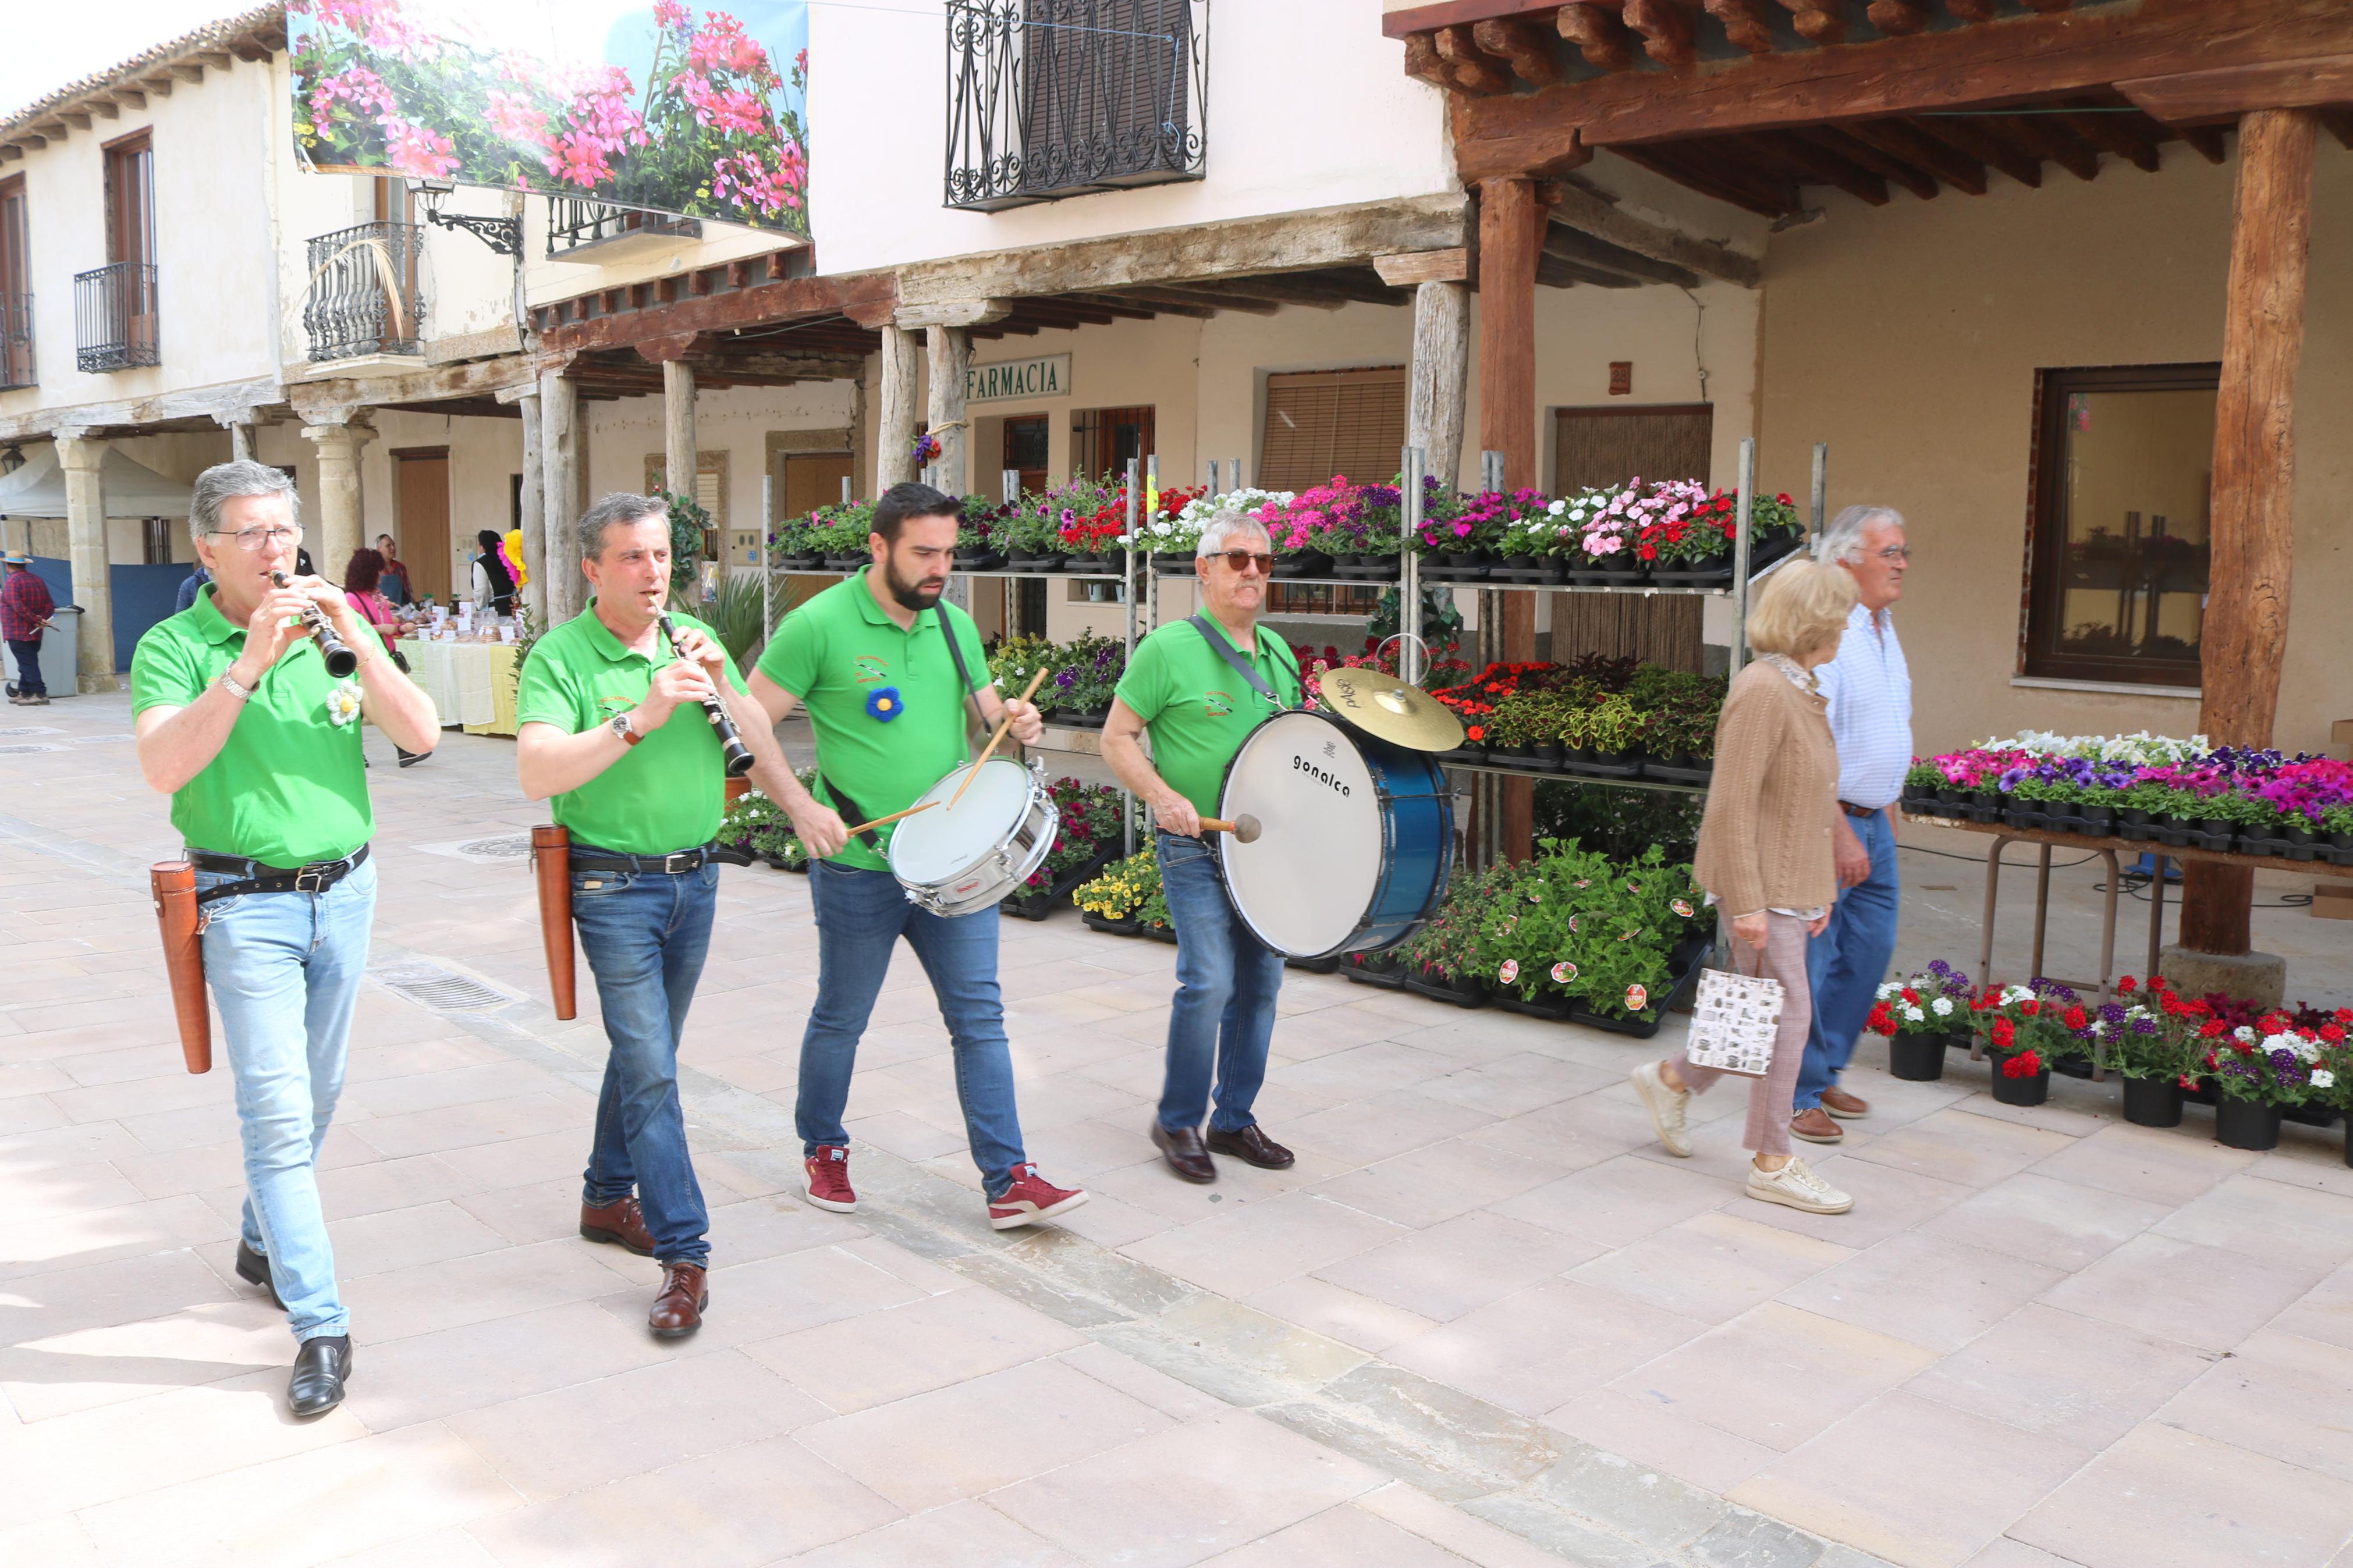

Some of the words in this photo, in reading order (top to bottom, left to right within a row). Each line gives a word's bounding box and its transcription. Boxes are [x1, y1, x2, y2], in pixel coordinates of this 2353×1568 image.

[966, 362, 1057, 399] FARMACIA
[1613, 369, 1627, 382] 28
[1293, 755, 1350, 798] gonalca
